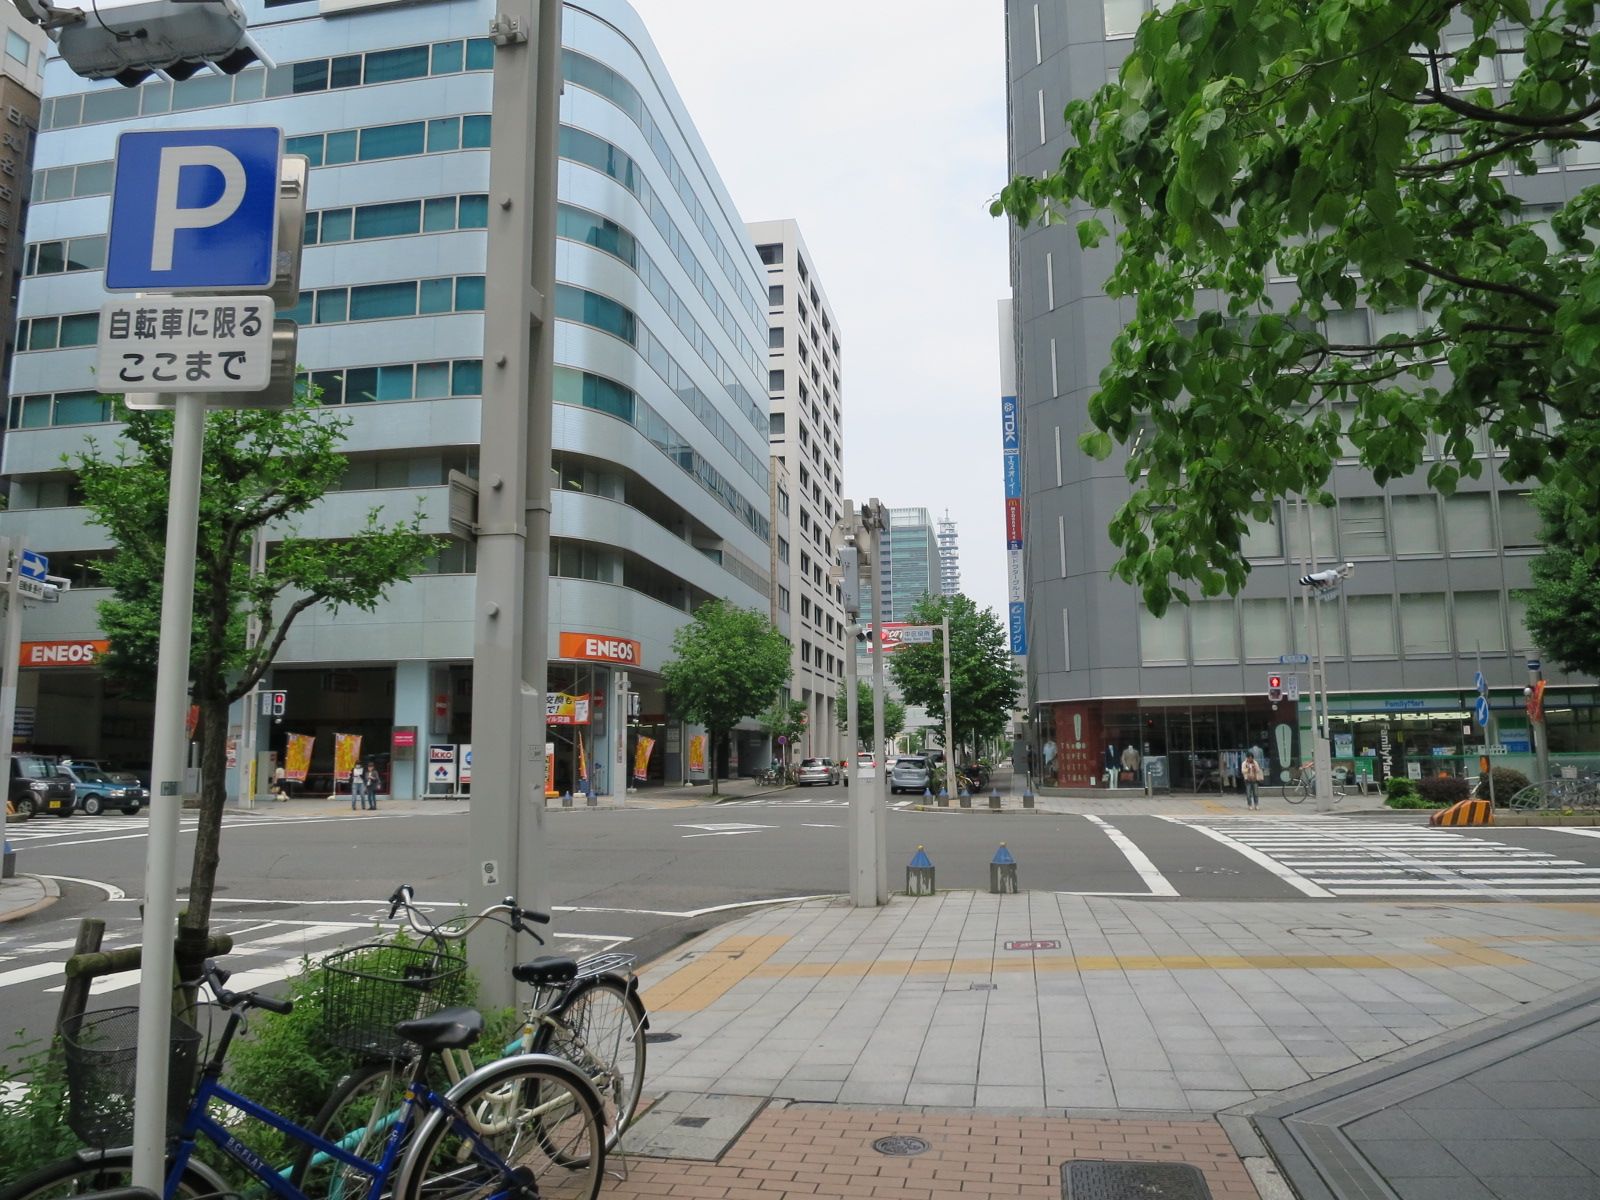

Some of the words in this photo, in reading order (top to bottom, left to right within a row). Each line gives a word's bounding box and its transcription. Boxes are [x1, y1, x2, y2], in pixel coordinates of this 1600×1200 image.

[150, 145, 247, 272] P
[109, 306, 262, 340] 自転車に限る
[118, 350, 246, 382] ここまで
[1004, 413, 1016, 442] TDK
[31, 644, 94, 662] ENEOS
[586, 638, 633, 660] ENEOS
[1384, 700, 1425, 709] FamilyMart
[1379, 723, 1394, 781] FamilyMart
